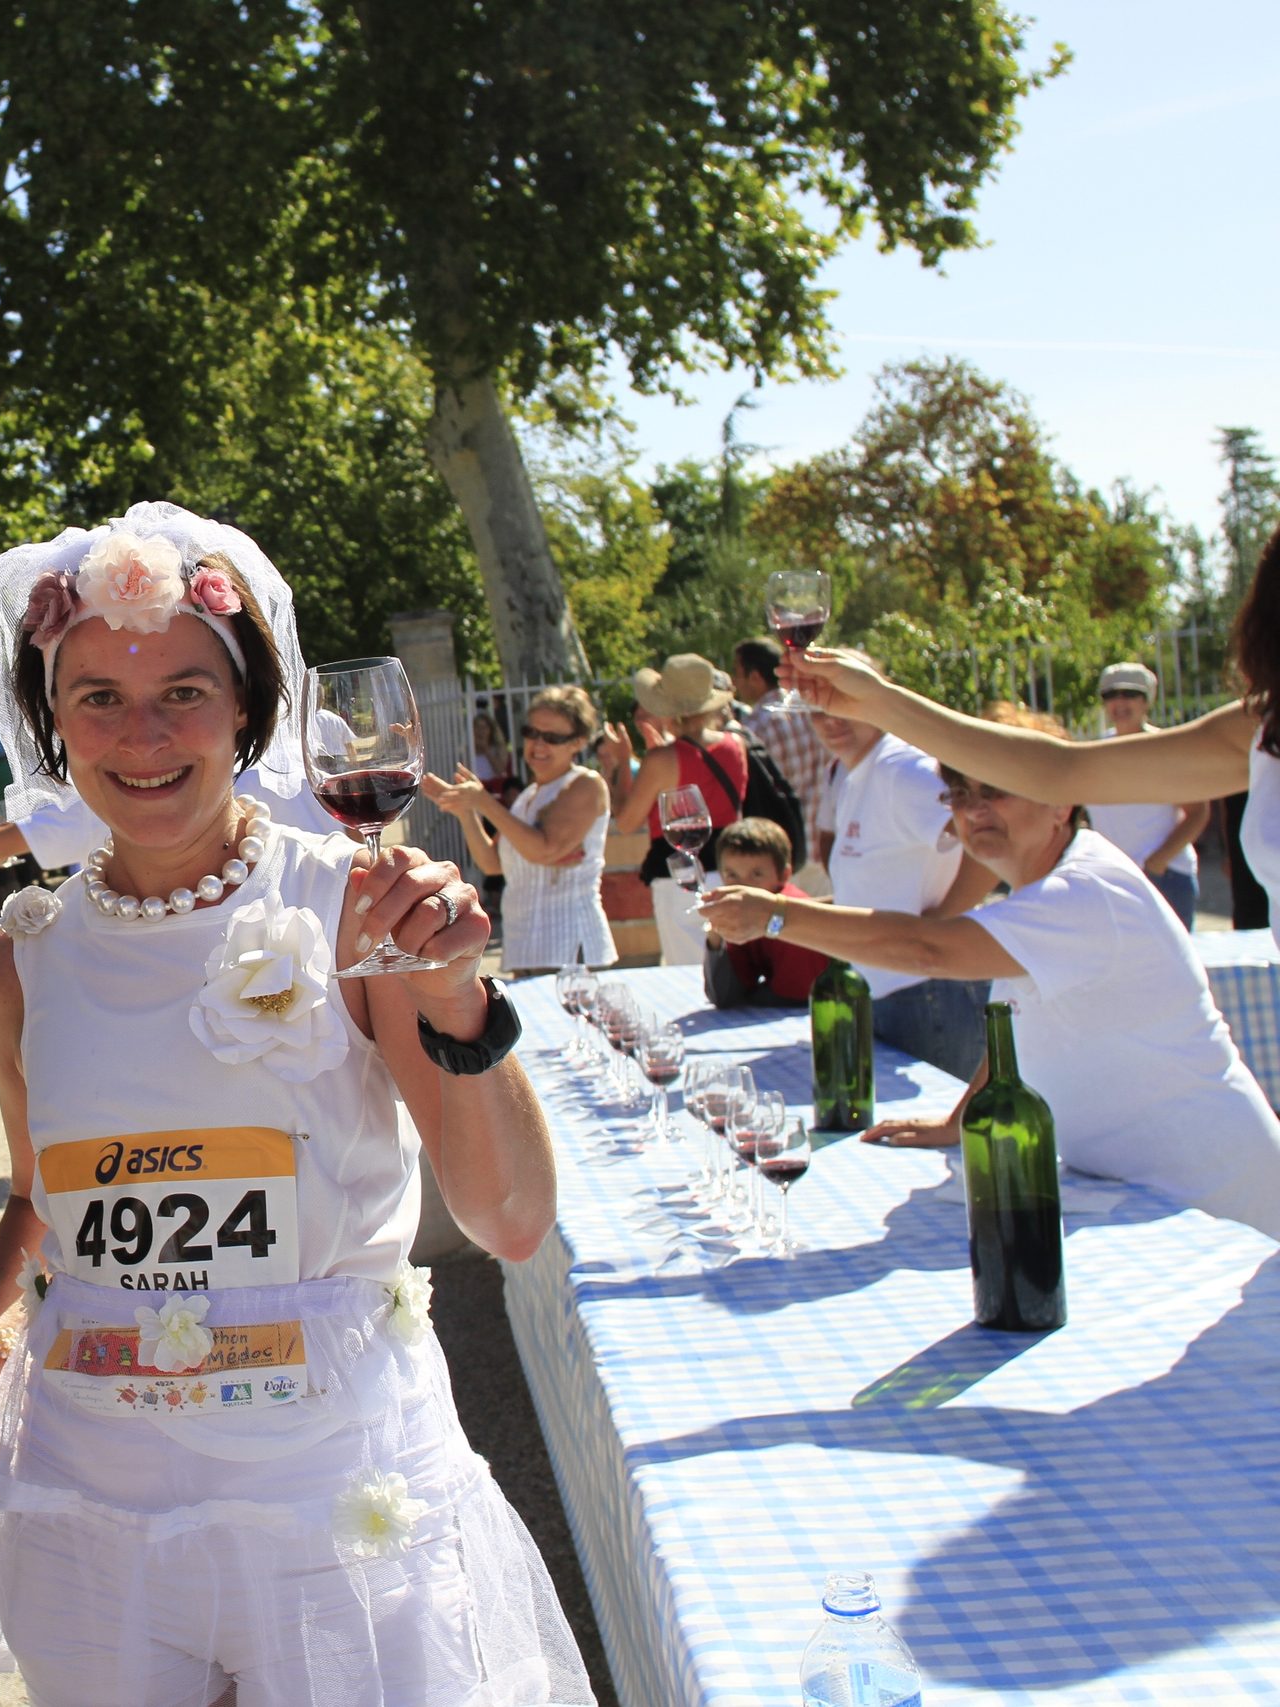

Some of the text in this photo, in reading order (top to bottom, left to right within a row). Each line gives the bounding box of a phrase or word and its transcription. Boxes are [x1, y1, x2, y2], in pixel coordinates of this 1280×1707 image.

[75, 1189, 277, 1267] 4924
[120, 1270, 209, 1291] SARAH
[207, 1346, 273, 1366] Médoc
[263, 1379, 299, 1392] Volvic
